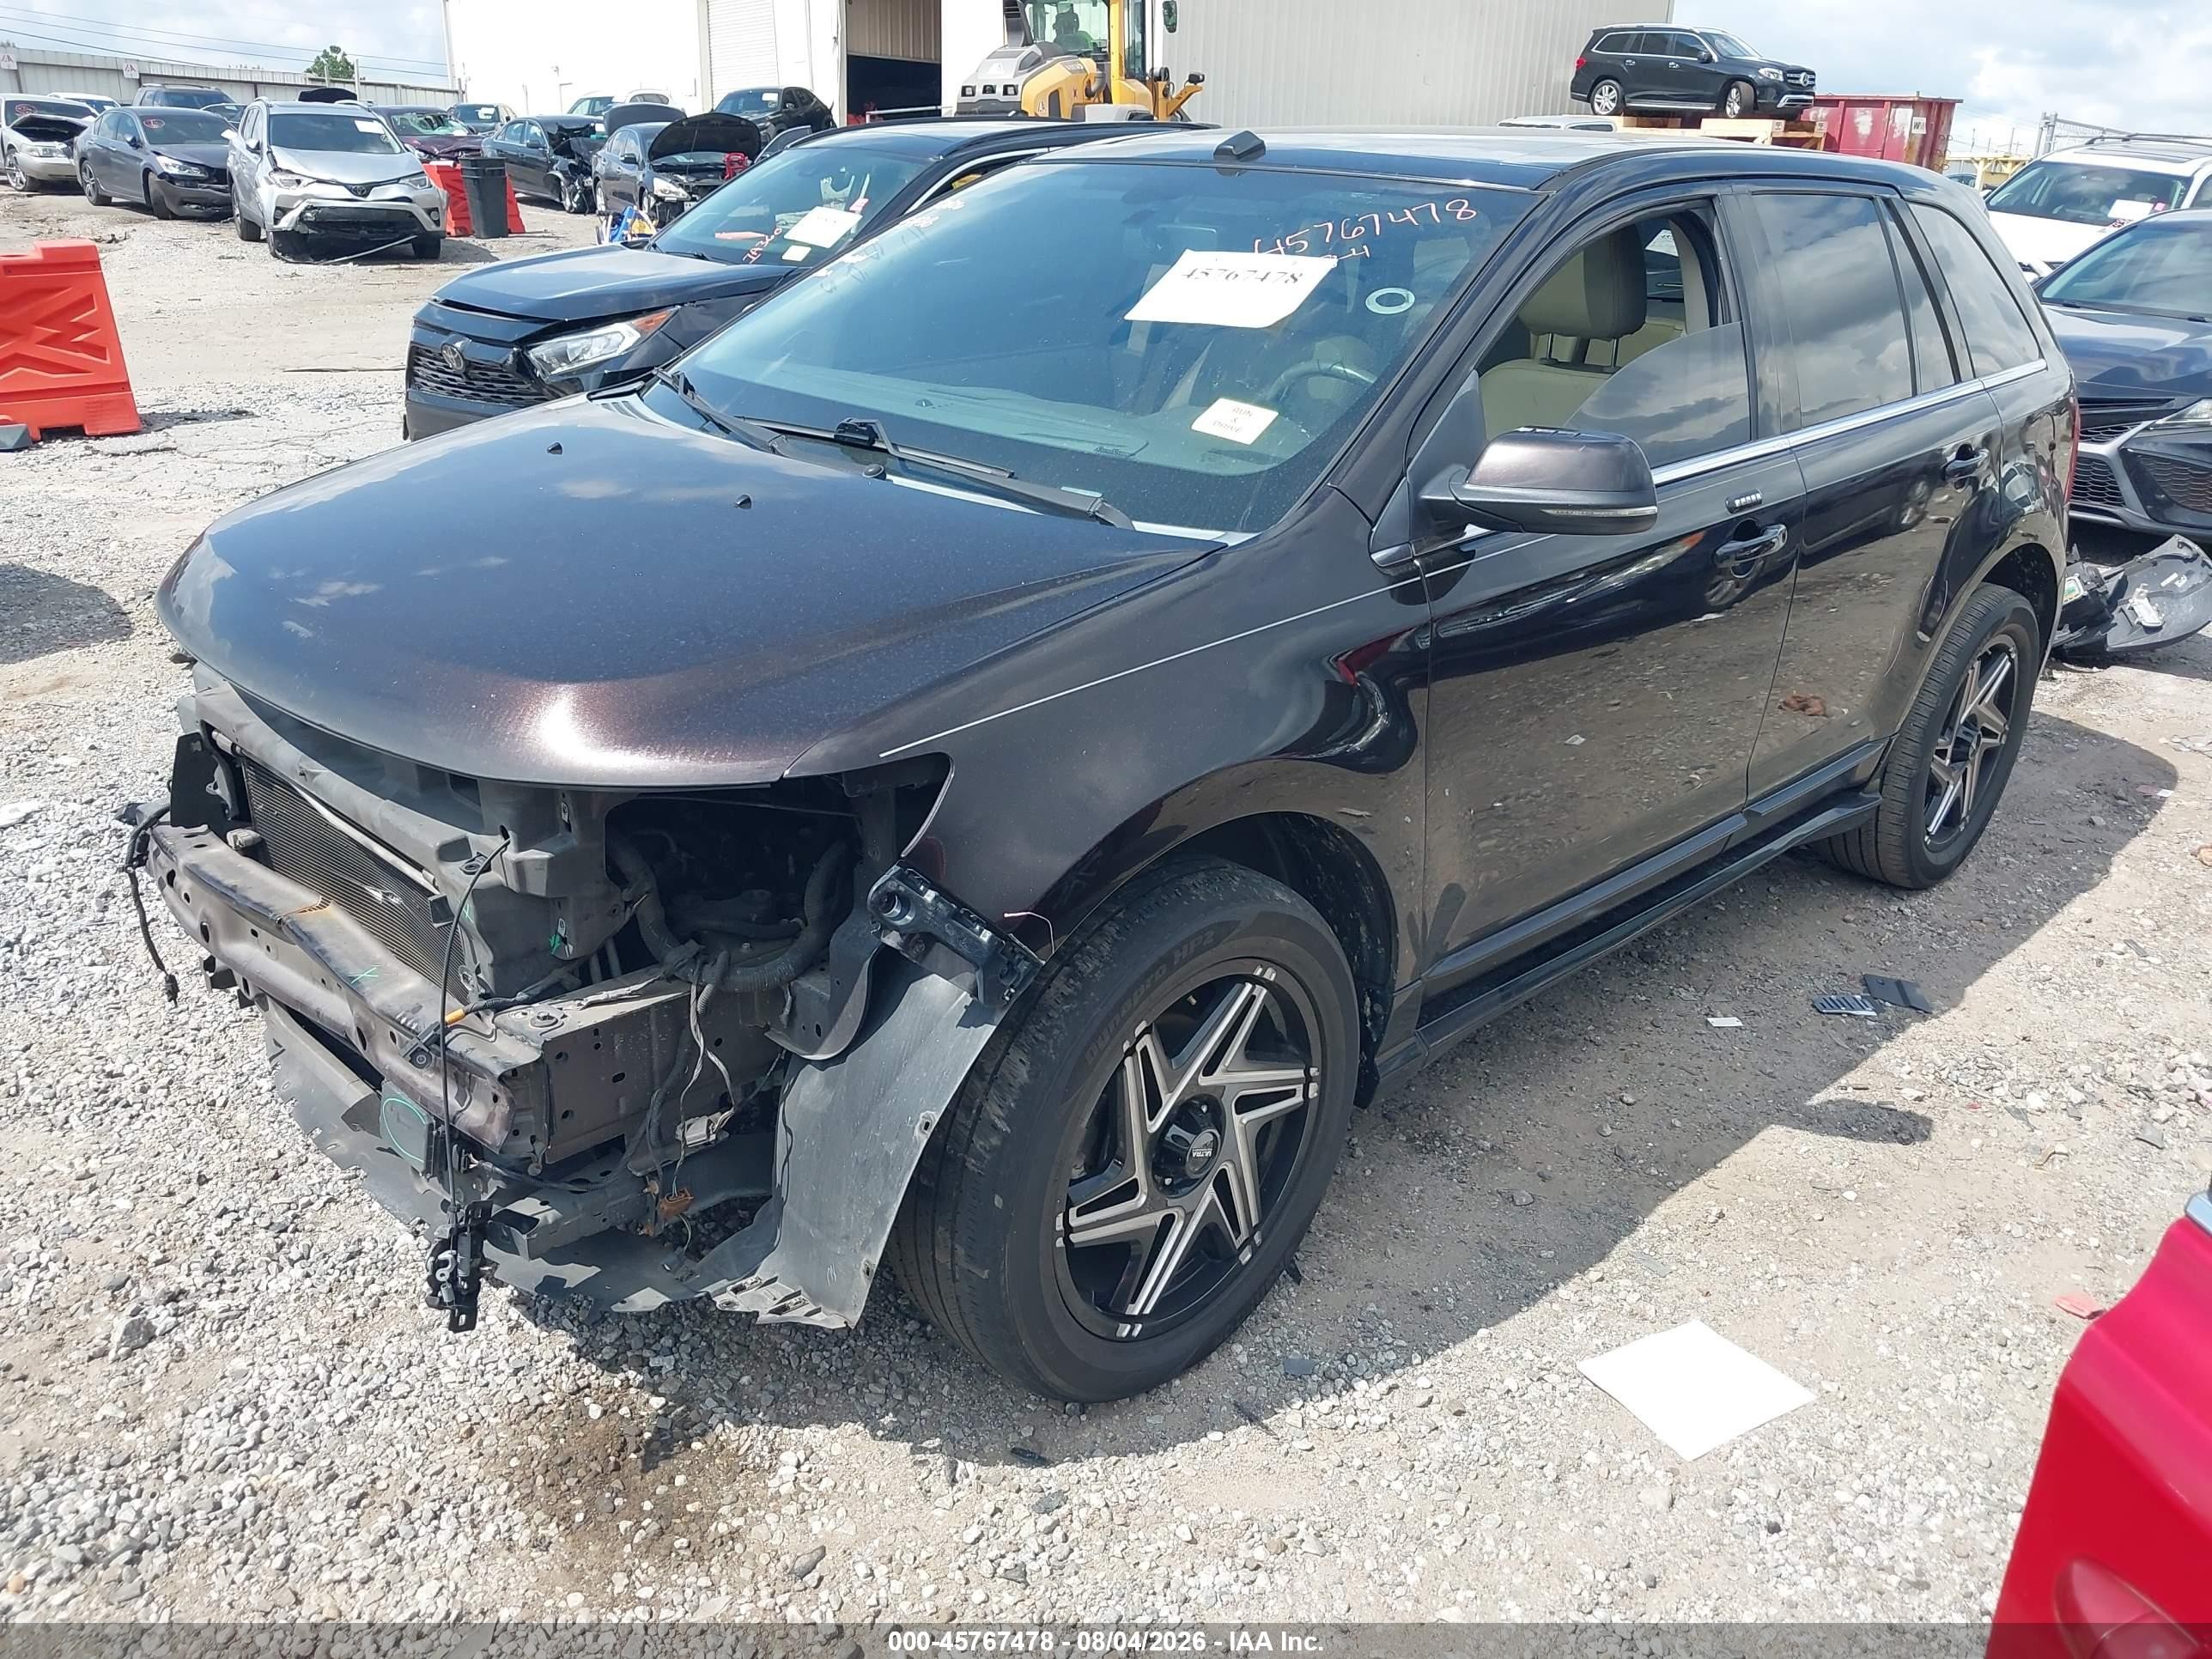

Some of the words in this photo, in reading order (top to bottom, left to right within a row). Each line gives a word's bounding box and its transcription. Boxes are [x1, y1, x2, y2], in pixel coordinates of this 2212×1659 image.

[1254, 198, 1478, 256] 45767478
[1182, 267, 1304, 284] 45767478
[1231, 406, 1254, 418] RUN
[1212, 420, 1243, 433] DRIVE
[1173, 930, 1214, 965] HP2
